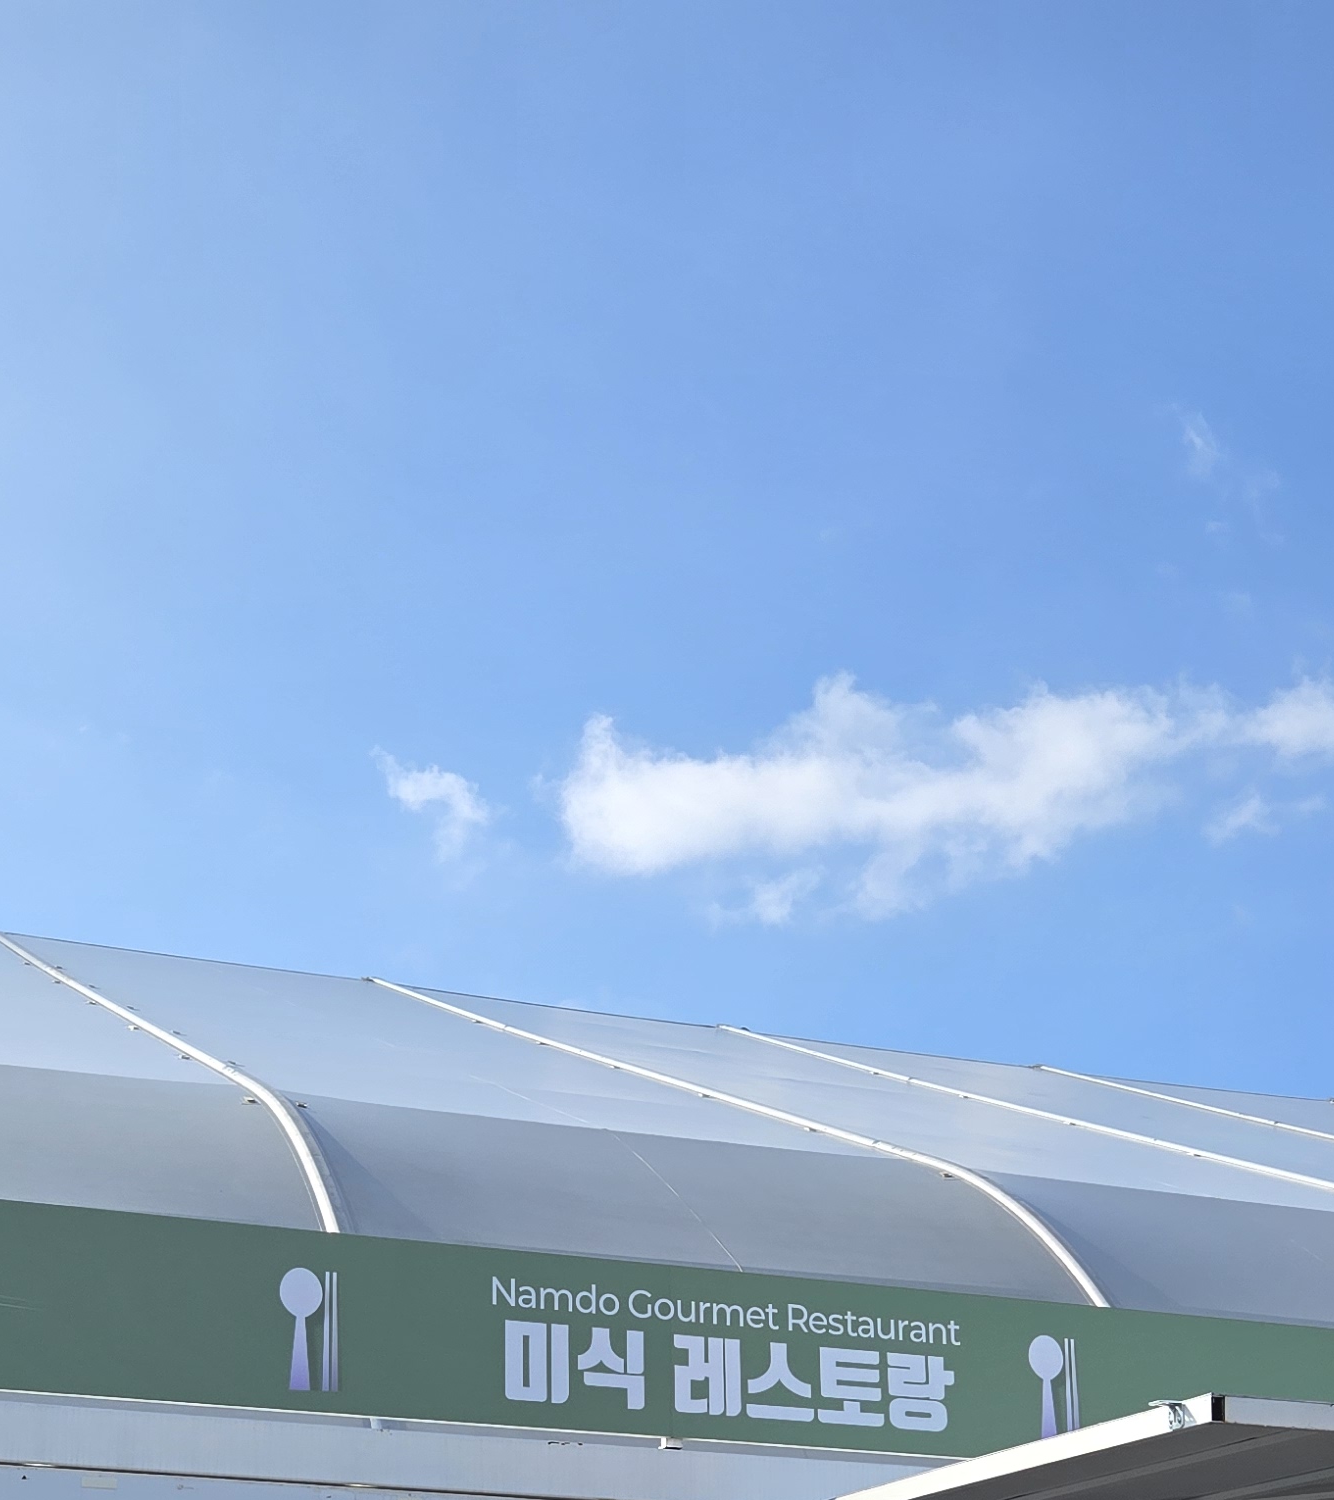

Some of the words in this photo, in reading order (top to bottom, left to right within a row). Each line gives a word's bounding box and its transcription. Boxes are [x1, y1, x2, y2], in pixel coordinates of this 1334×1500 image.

[491, 1276, 620, 1318] Namdo
[627, 1288, 779, 1332] Gourmet
[787, 1303, 961, 1347] Restaurant
[504, 1318, 646, 1411] 미식
[672, 1334, 955, 1433] 레스토랑
